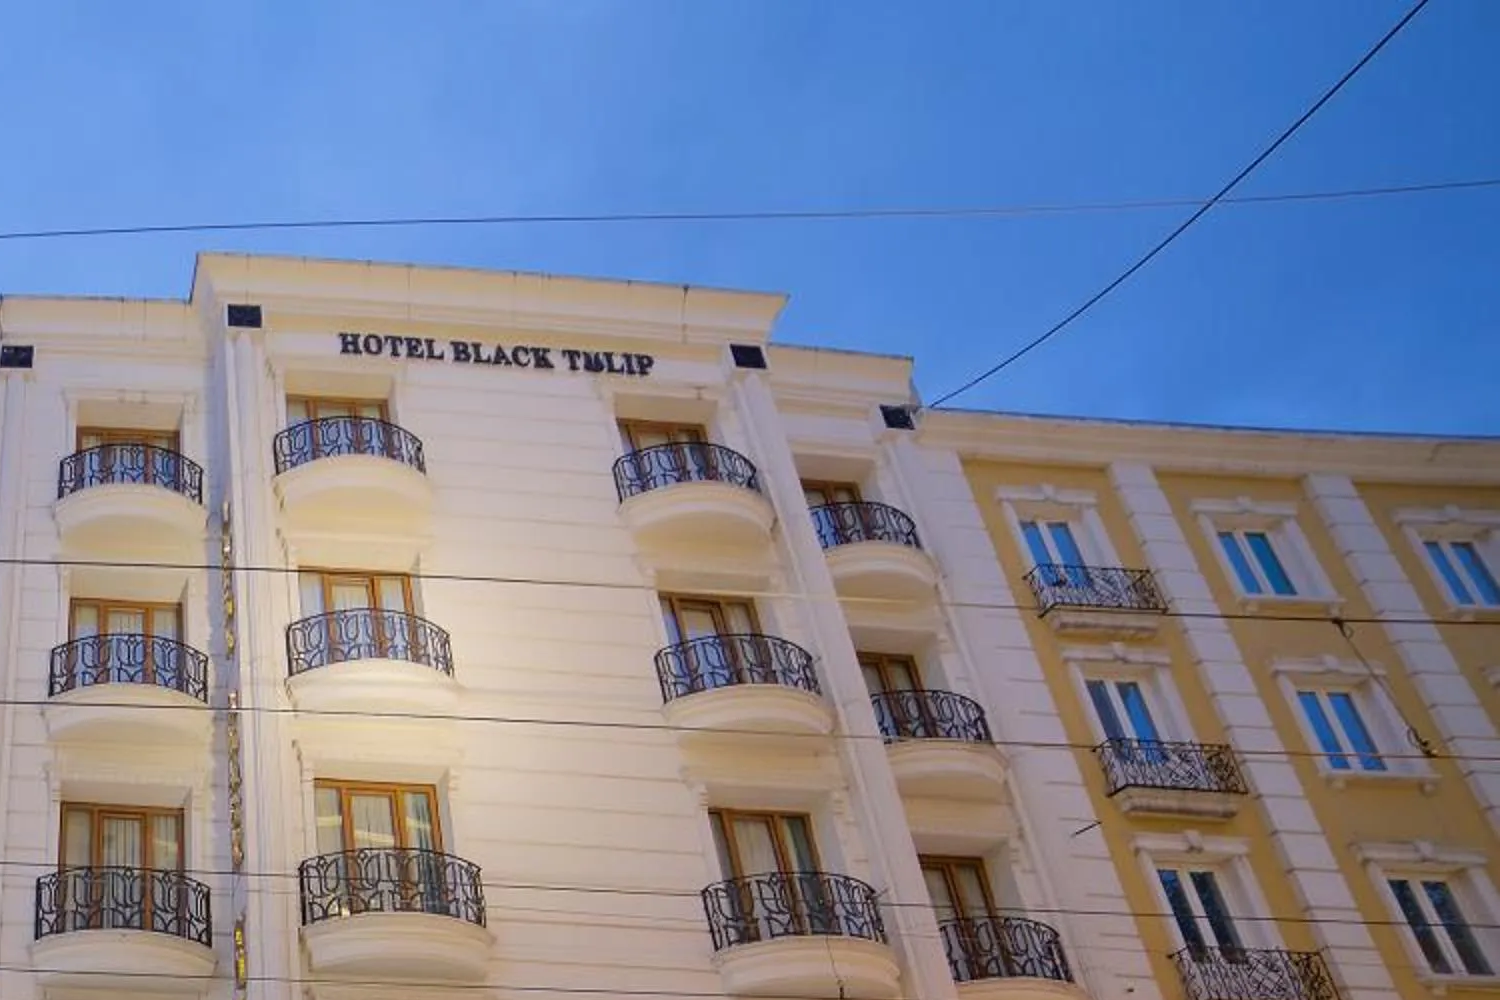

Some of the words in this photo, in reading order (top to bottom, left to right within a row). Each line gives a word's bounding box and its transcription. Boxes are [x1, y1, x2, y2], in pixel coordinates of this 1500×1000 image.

[338, 332, 444, 361] HOTEL
[449, 340, 554, 369] BLACK
[562, 349, 654, 376] TULIP
